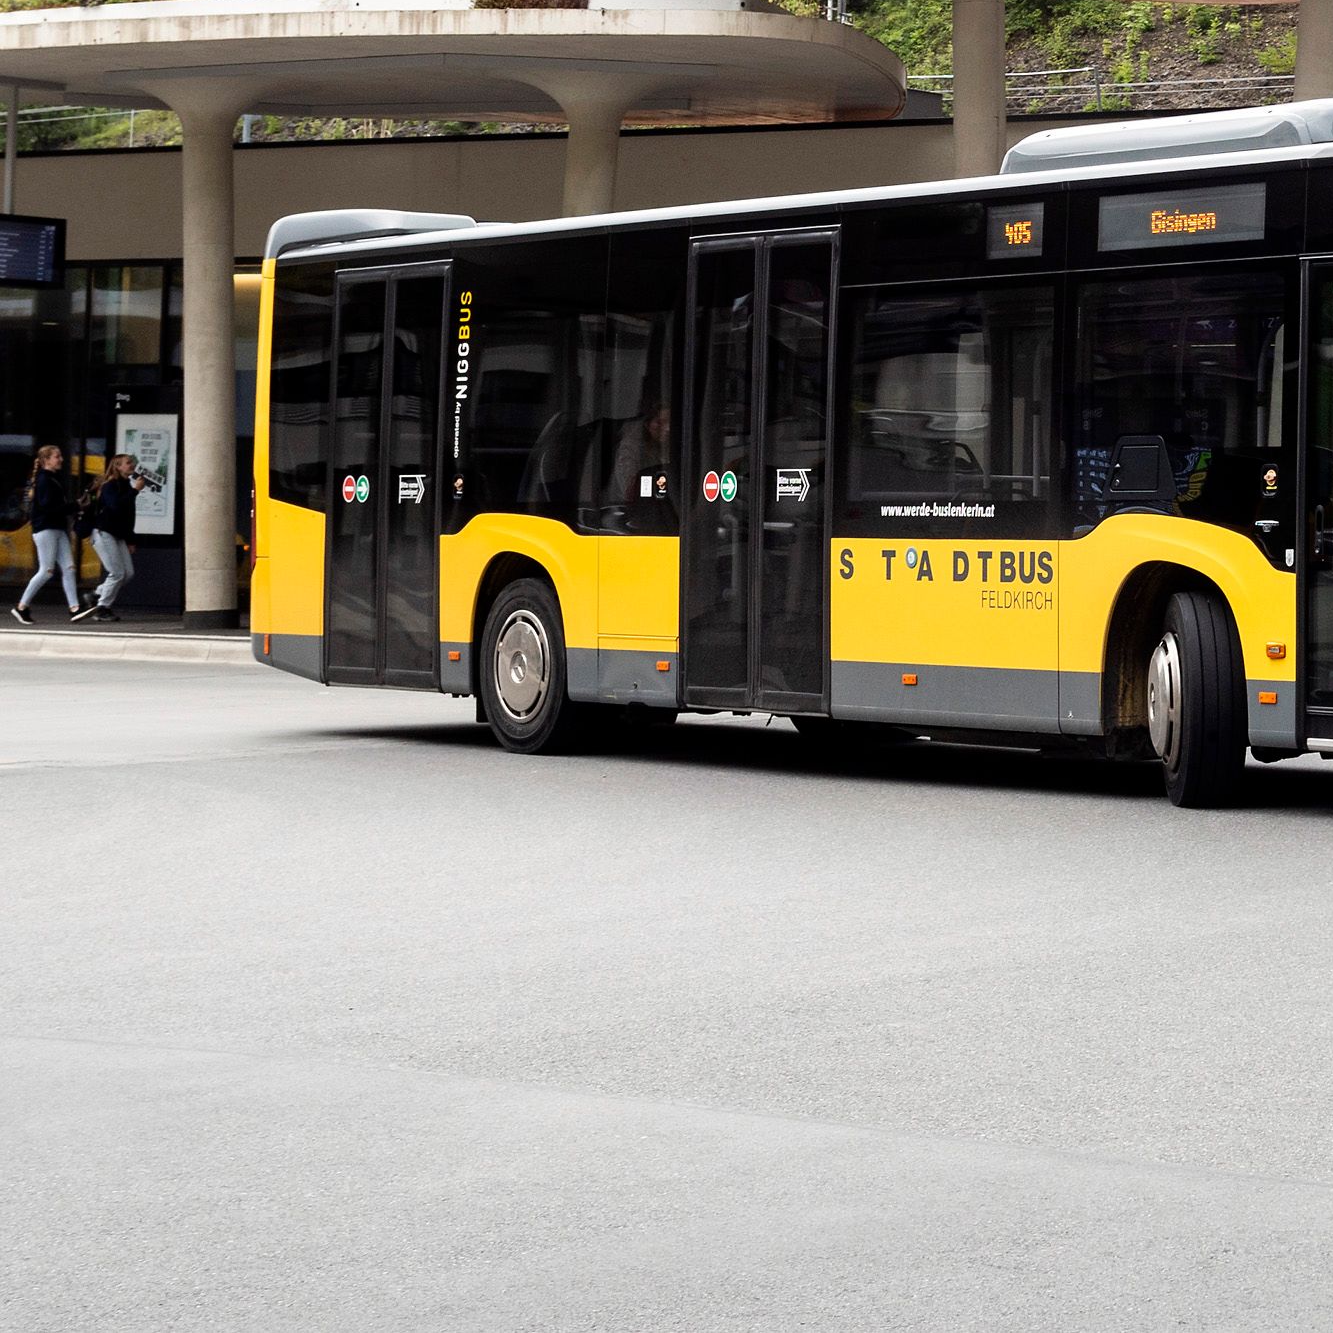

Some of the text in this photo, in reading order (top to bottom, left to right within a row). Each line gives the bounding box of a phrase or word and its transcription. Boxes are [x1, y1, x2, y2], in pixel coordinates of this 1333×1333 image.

[1005, 209, 1216, 245] 405 Gisingen
[453, 291, 473, 458] operated by NIGGBUS
[981, 590, 1053, 610] FELDKIRCH
